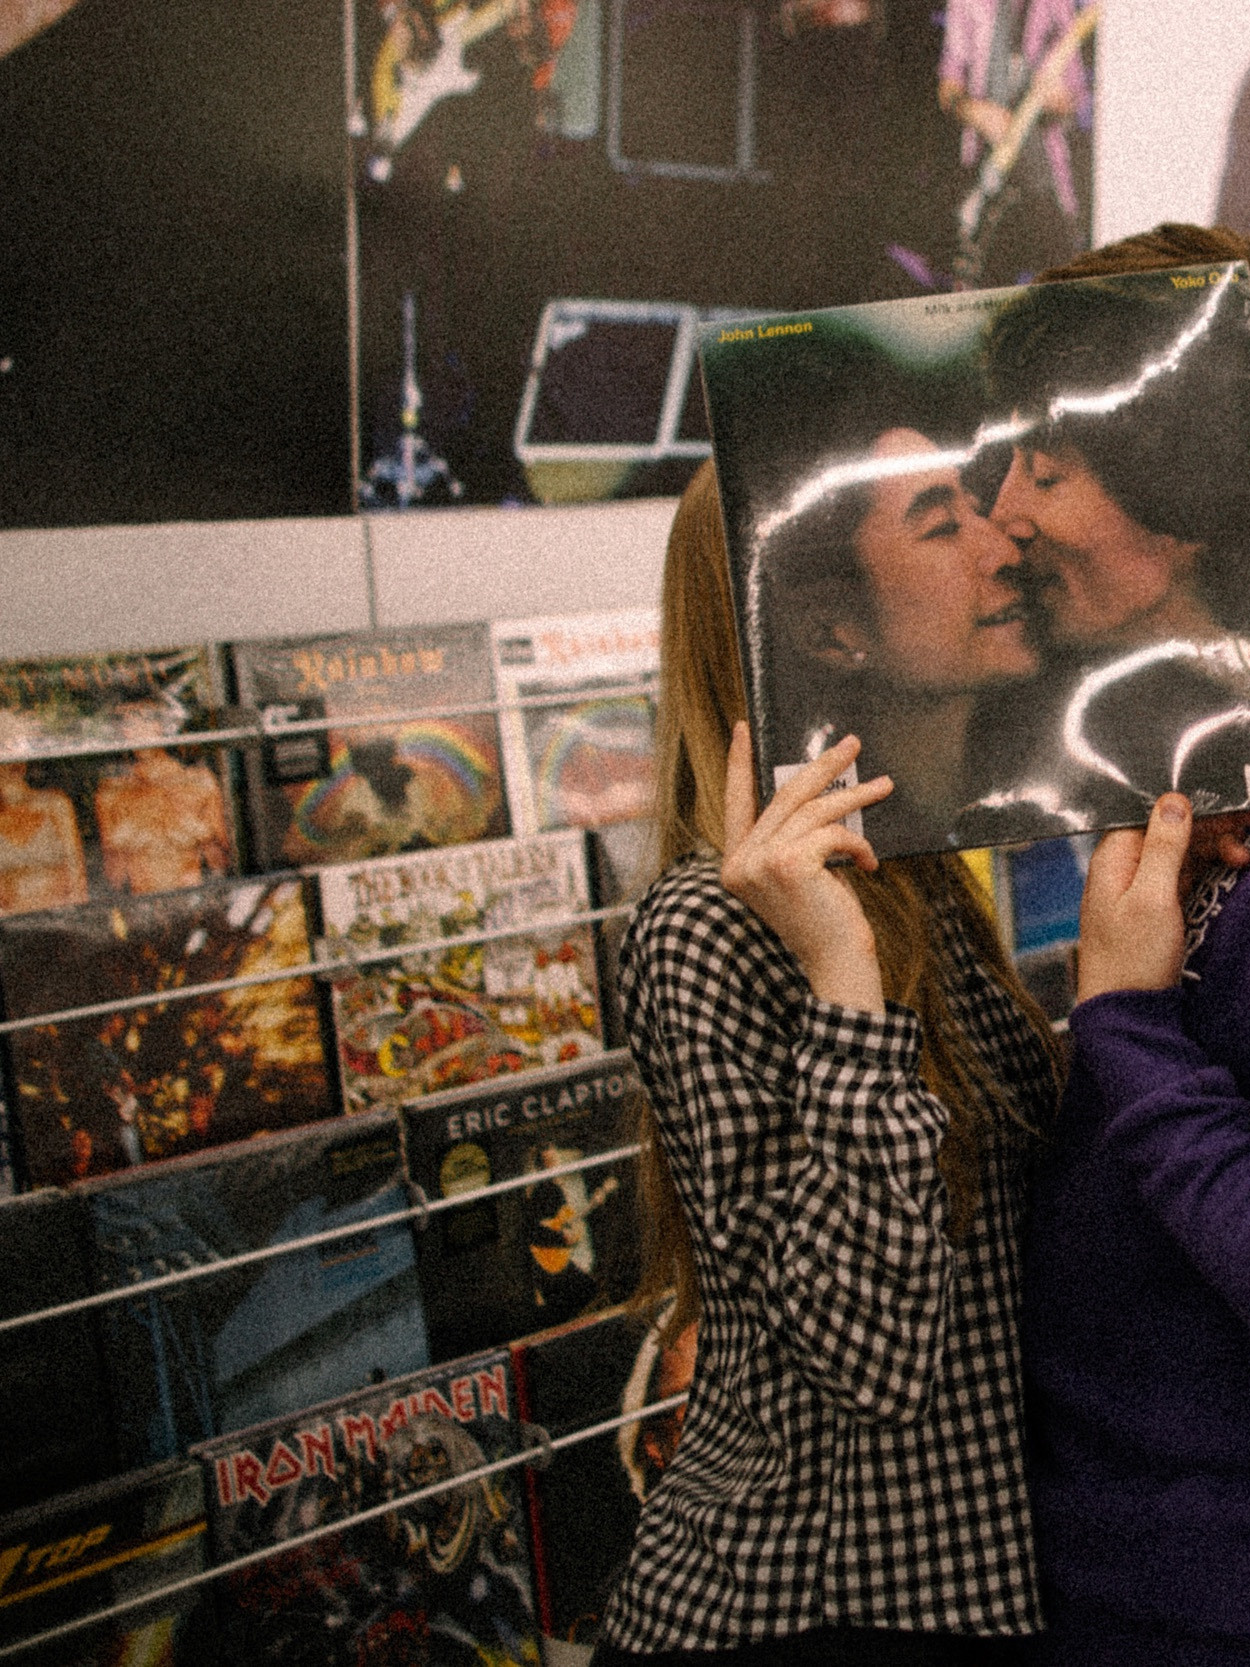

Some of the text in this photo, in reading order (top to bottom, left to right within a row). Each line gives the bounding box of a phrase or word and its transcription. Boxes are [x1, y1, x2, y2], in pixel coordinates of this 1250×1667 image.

[1169, 270, 1240, 290] Yoko Oo
[717, 321, 814, 343] John Lennon
[291, 645, 444, 694] Rainbow
[446, 1102, 511, 1140] ERIC
[214, 1363, 511, 1508] IRON MAIDEN
[24, 1522, 113, 1576] TOP
